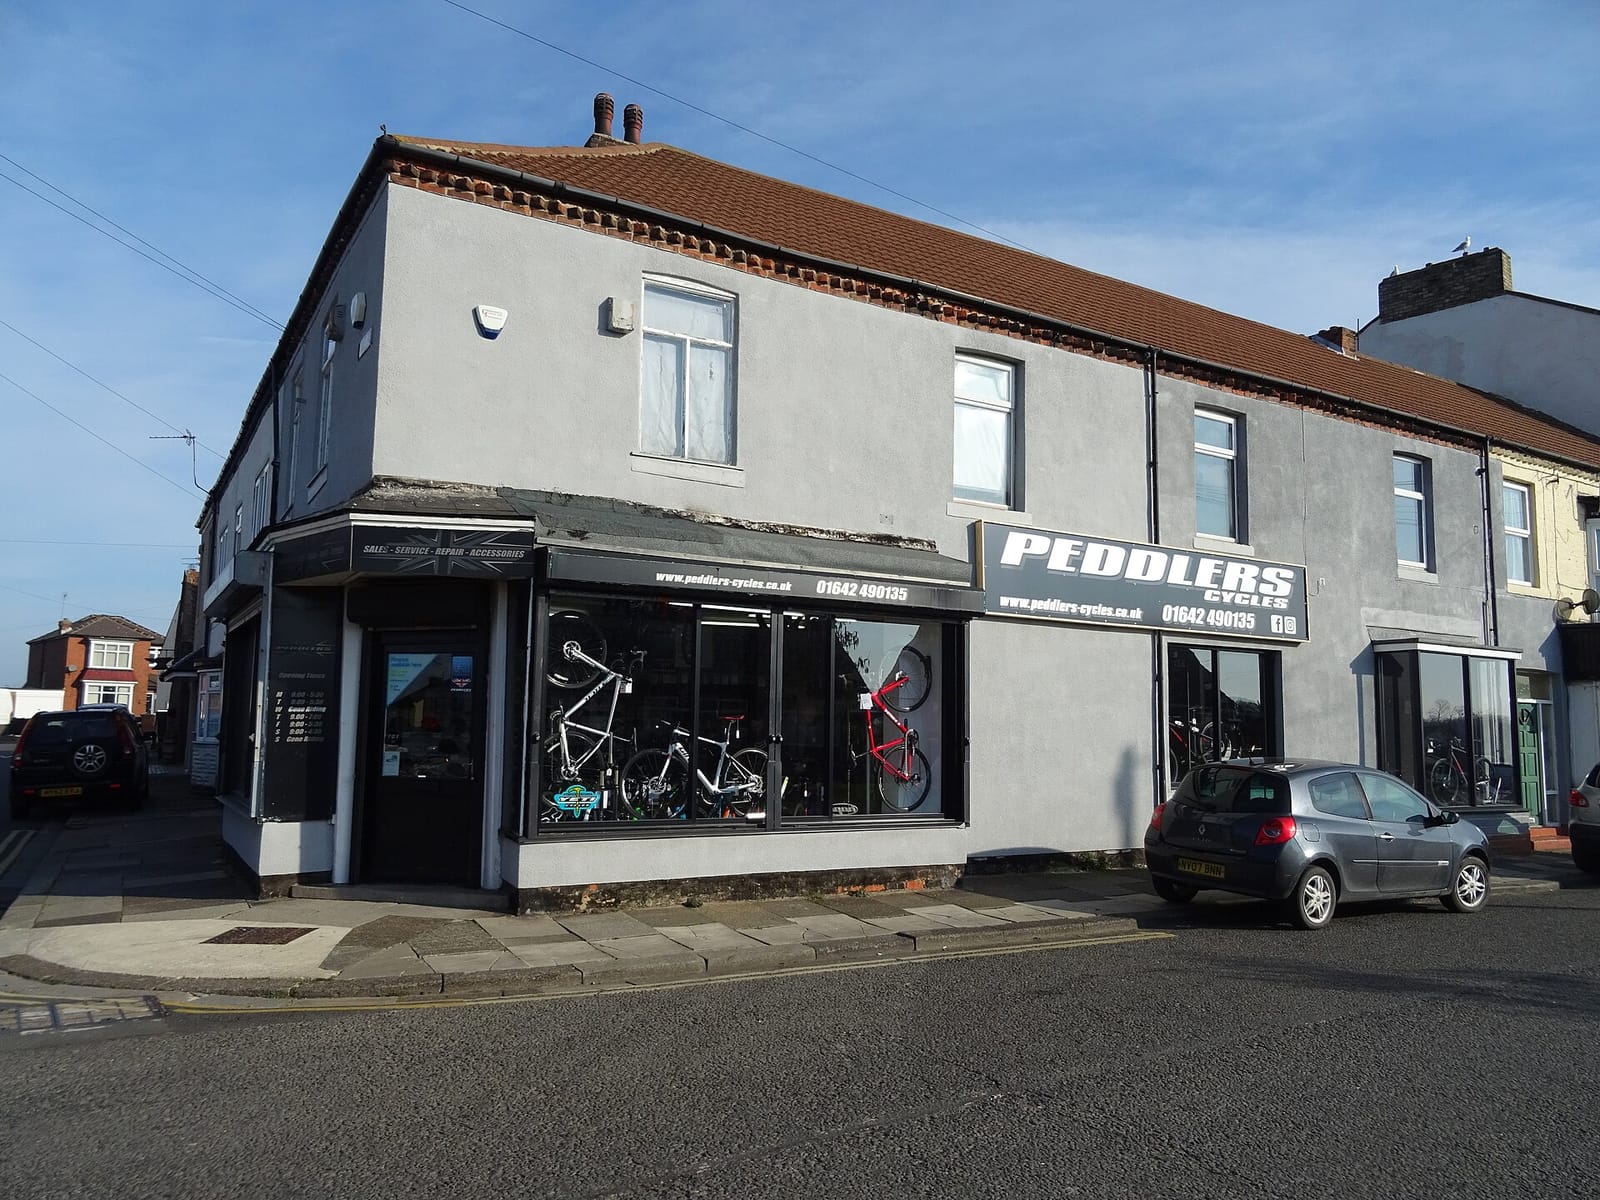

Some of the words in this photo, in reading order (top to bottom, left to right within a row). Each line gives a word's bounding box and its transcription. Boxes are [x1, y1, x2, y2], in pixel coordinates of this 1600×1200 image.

[363, 545, 389, 554] SALES
[394, 546, 431, 555] SERVICE
[435, 547, 465, 556] REPAIR
[469, 549, 525, 559] ACCESSORIES
[1000, 531, 1295, 597] PEDDLERS
[656, 572, 792, 592] www.peddlers-cycles.co.uk
[816, 580, 857, 597] 01642
[859, 583, 908, 602] 490135
[1203, 590, 1289, 609] CYCLES
[1000, 595, 1143, 621] www.peddlers-cycles.co.uk
[1162, 604, 1205, 625] 01642
[1206, 607, 1255, 630] 490135
